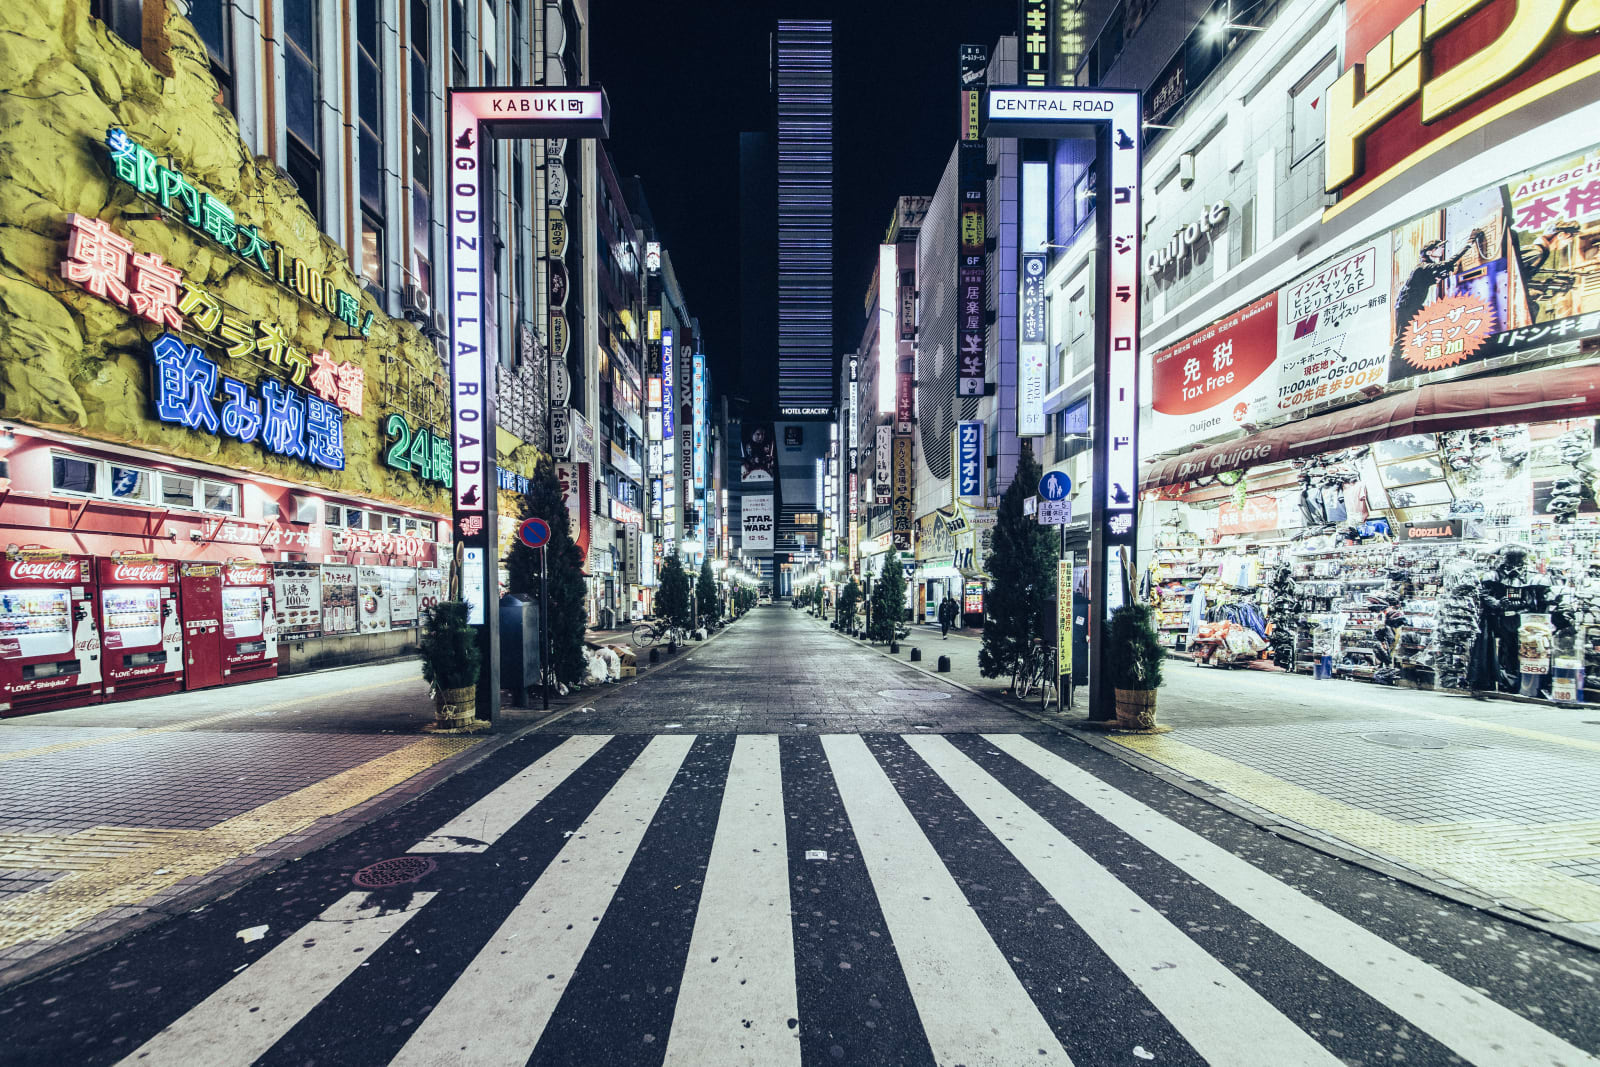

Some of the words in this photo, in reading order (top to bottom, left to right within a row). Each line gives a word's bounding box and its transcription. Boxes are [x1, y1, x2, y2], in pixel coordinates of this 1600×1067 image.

[996, 99, 1068, 111] CENTRAL
[1072, 100, 1114, 112] ROAD
[1144, 199, 1230, 277] Quijote
[455, 157, 479, 357] GODZILLA
[966, 256, 980, 265] 6F
[1113, 185, 1136, 452] ゴジラロード
[1323, 300, 1348, 318] ホテル
[1324, 293, 1388, 327] グレイスリー新宿
[1412, 304, 1484, 334] レーザー
[1411, 318, 1483, 349] ギミック
[1423, 338, 1465, 361] 追加
[681, 345, 692, 407] SHIDAX
[1303, 360, 1329, 377] 現在地
[150, 332, 346, 471] 飲み放題
[1182, 382, 1204, 402] Tax
[1206, 371, 1235, 394] Free
[457, 381, 480, 475] ROAD
[682, 430, 691, 447] BIC
[1188, 416, 1222, 433] Quijote
[682, 450, 691, 477] DRUG
[961, 427, 978, 493] カラオケ
[1177, 459, 1206, 479] Don
[1210, 442, 1272, 470] Quijote
[743, 515, 773, 523] STAR
[743, 524, 773, 532] WARS
[1408, 526, 1453, 538] GODZILLA
